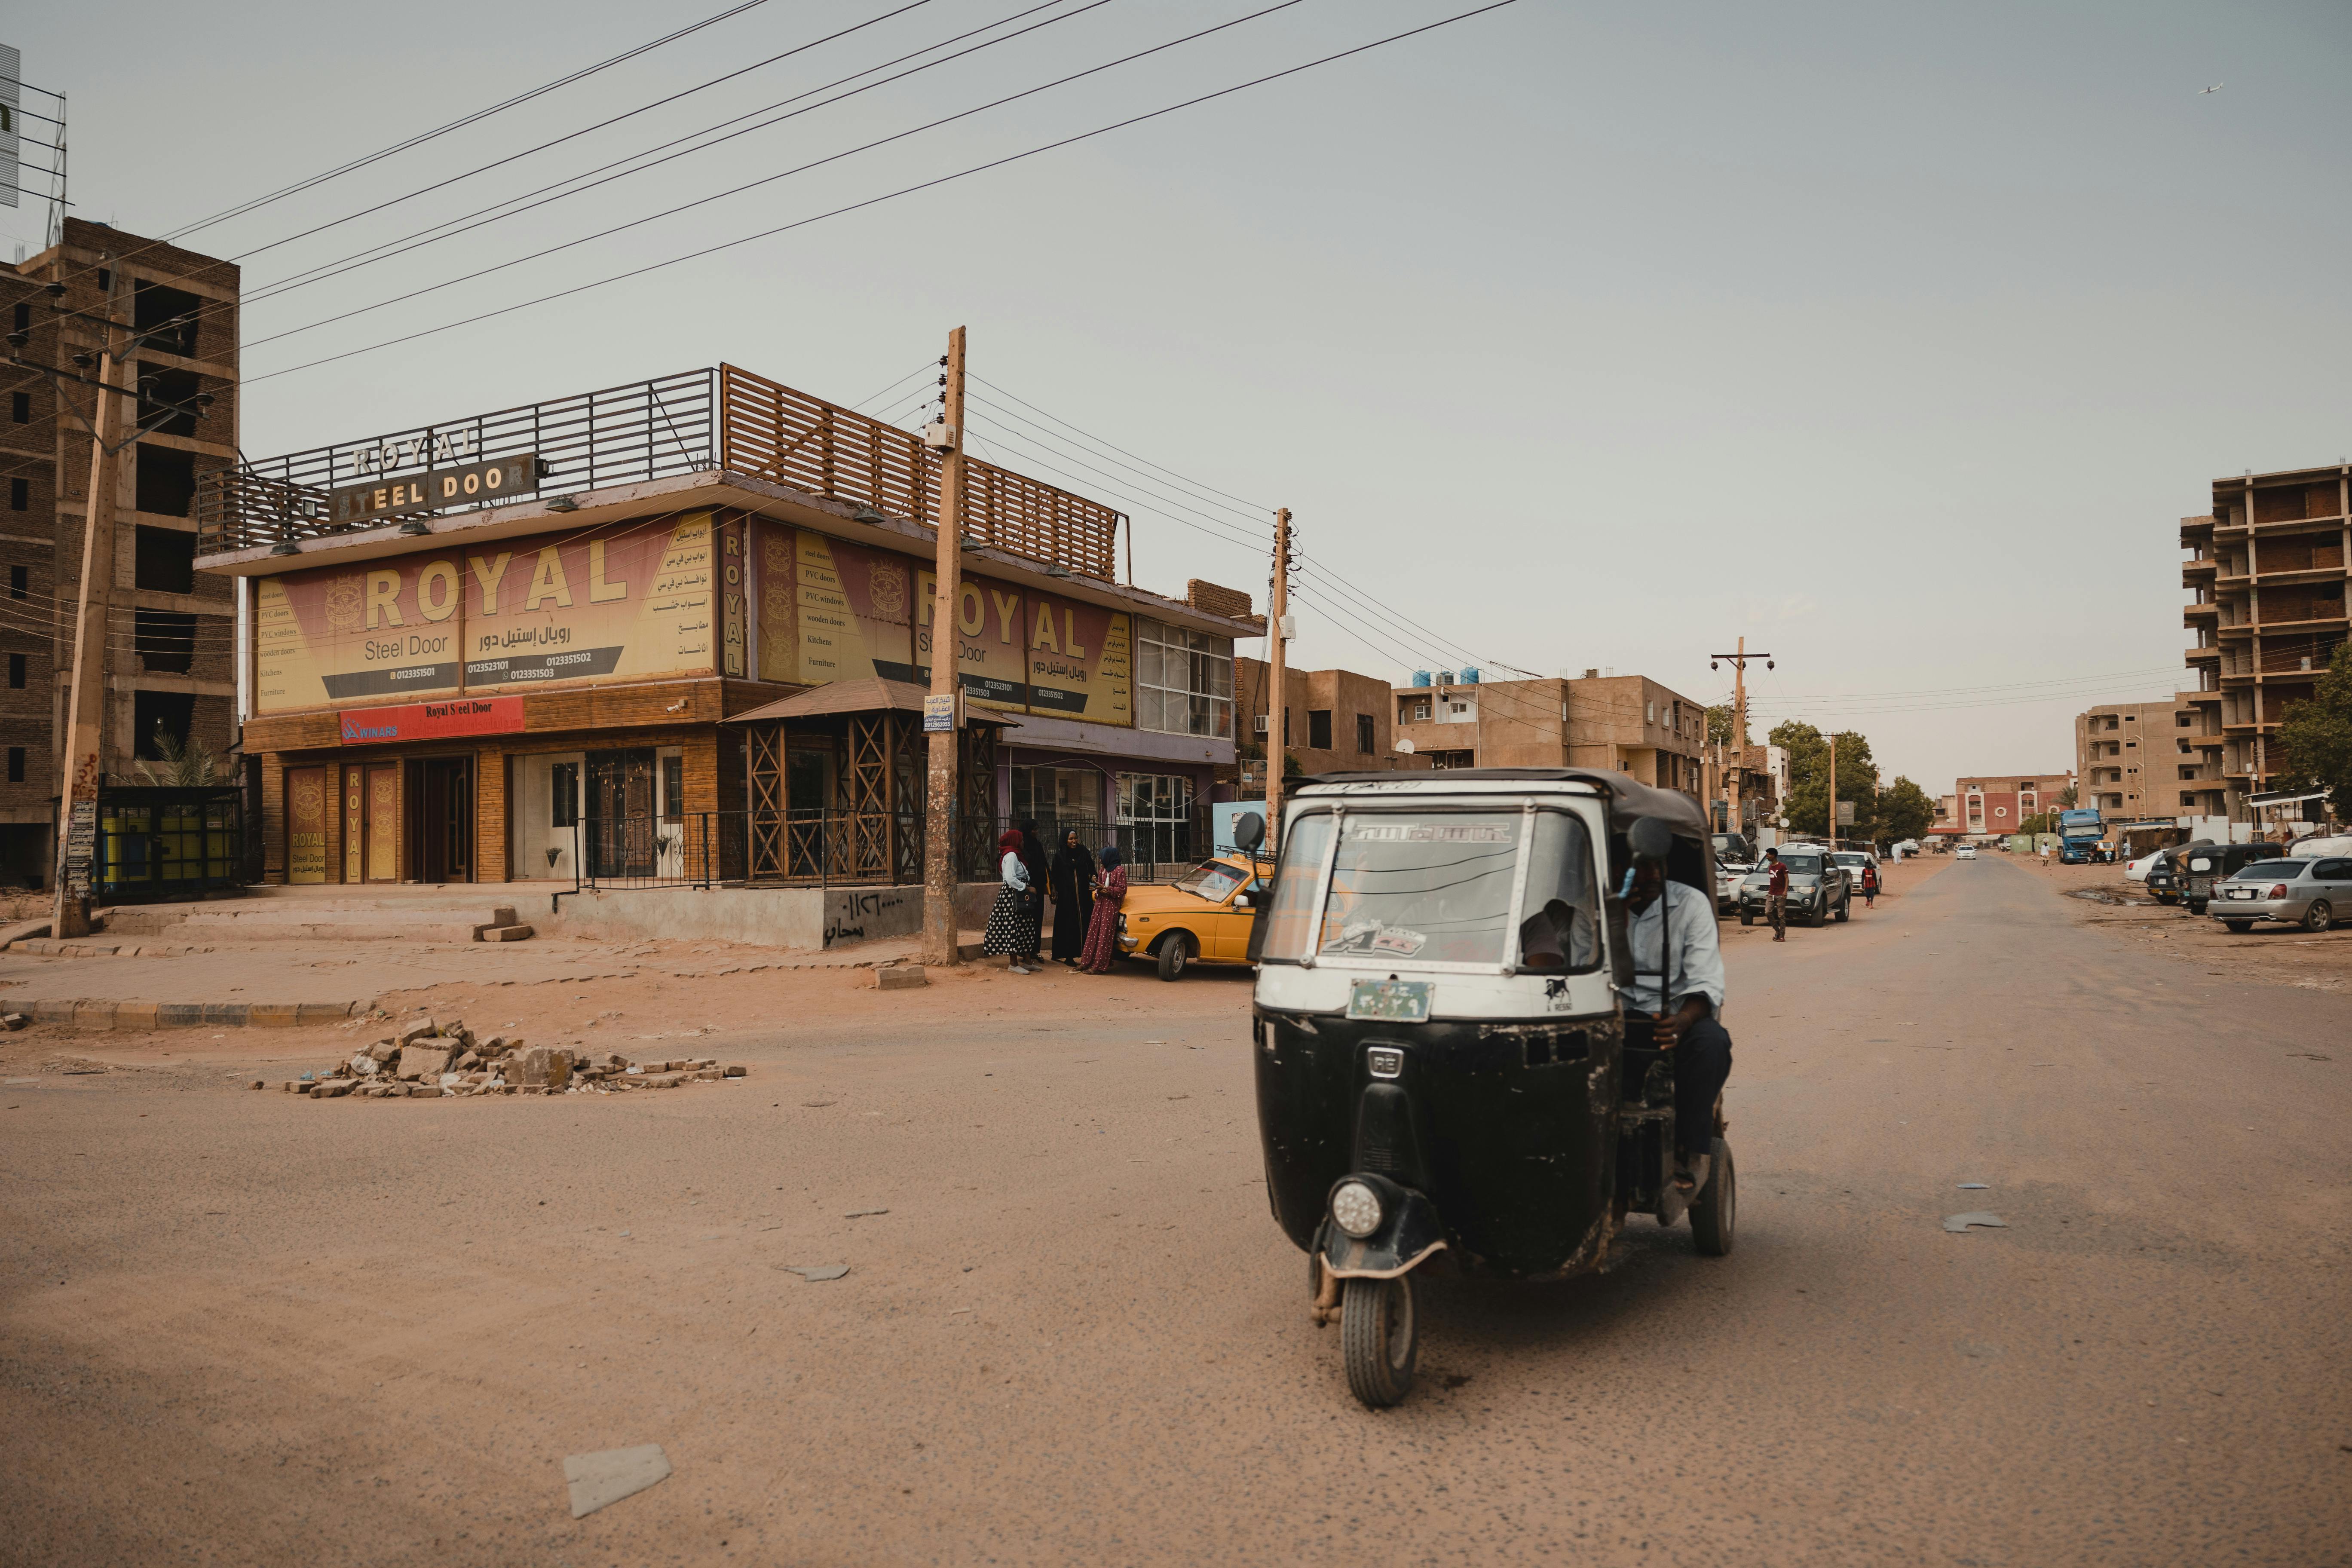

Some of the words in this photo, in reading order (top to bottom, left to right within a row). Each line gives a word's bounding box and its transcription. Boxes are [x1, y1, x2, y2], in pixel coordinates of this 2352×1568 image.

[353, 429, 479, 475] ROYAL
[805, 550, 816, 558] steel
[816, 551, 830, 560] doors
[365, 538, 627, 630] ROYAL
[805, 570, 819, 580] PVC
[819, 572, 836, 583] doors
[726, 535, 741, 676] ROYAL
[805, 591, 819, 601] PVC
[820, 594, 844, 606] windows
[807, 614, 828, 625] wooden
[830, 616, 845, 627] doors
[274, 628, 296, 637] windows
[501, 628, 536, 648] إستيل
[539, 626, 570, 644] رويال
[365, 637, 404, 661] Steel
[409, 634, 448, 656] Door
[479, 635, 499, 652] دور
[807, 635, 832, 646] Kitchens
[260, 649, 279, 658] wooden
[958, 640, 986, 663] Door
[468, 661, 509, 674] 0123523101
[546, 652, 591, 666] 0123351502
[808, 657, 836, 668] Furniture
[1033, 661, 1045, 674] دور
[260, 669, 282, 677] Kitchens
[396, 667, 435, 680] 0123351501
[510, 668, 554, 680] 0123351503
[1046, 662, 1069, 680] إستيل
[1069, 667, 1087, 683] رويال
[260, 689, 285, 697] Furniture
[985, 680, 1012, 692] 0123523101
[1038, 689, 1063, 700] 0123351502
[426, 704, 448, 719] Royal
[450, 703, 470, 715] Seel
[472, 702, 492, 714] Door
[360, 726, 398, 738] WINARS
[349, 772, 359, 877] ROYAL
[292, 832, 325, 848] ROYAL
[292, 854, 308, 863] Steel
[309, 854, 325, 863] Door
